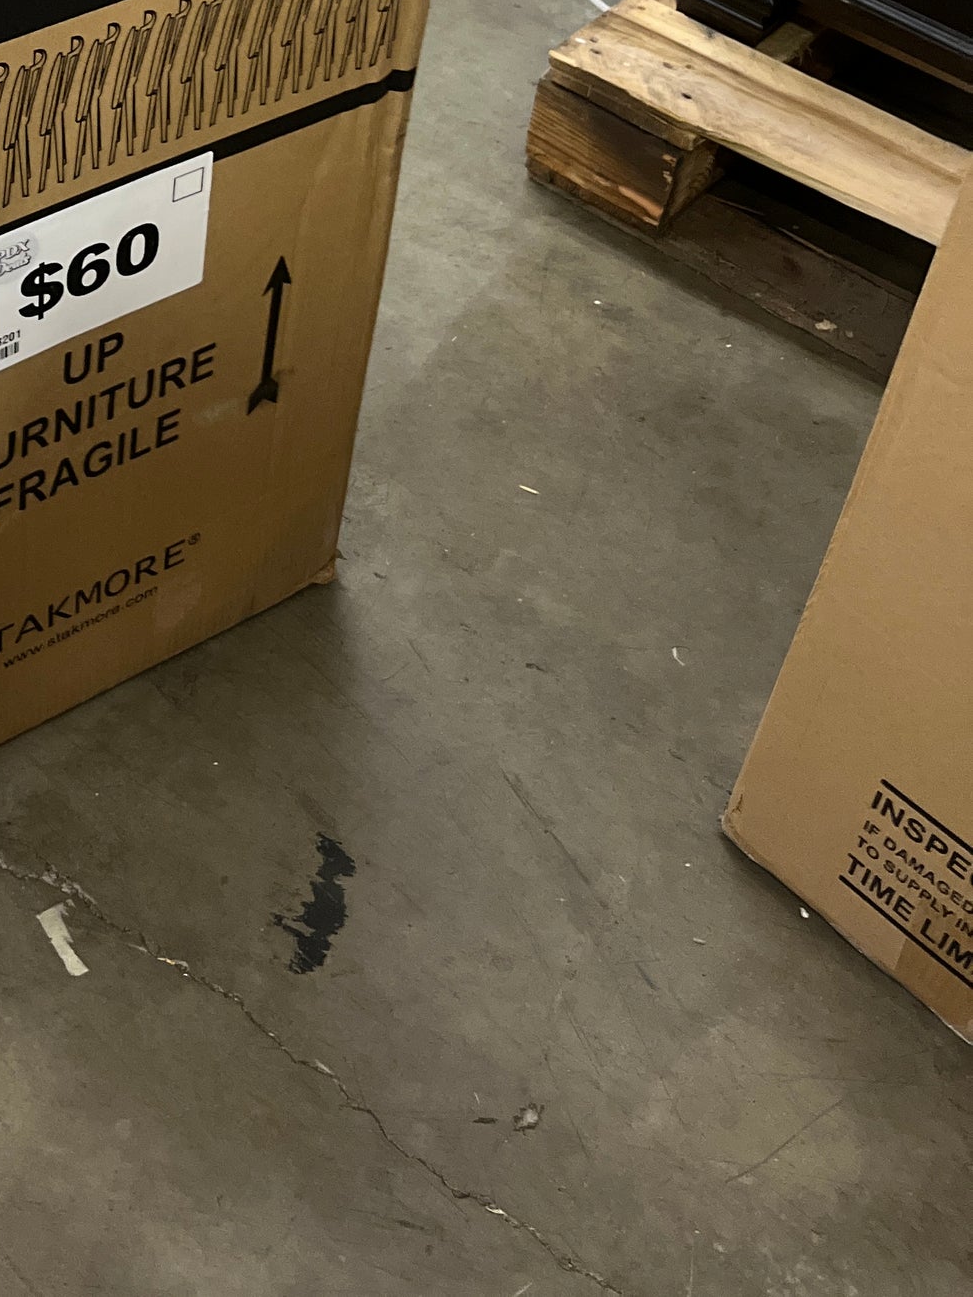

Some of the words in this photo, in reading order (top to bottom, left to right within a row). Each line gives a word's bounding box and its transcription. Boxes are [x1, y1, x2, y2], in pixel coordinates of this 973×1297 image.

[18, 222, 160, 321] $60
[63, 332, 124, 385] UP
[3, 586, 158, 668] www.stakmore.com
[863, 820, 881, 836] IF
[870, 790, 973, 886] INSPE
[847, 853, 915, 922] TIME
[857, 835, 879, 860] TO
[882, 860, 954, 918] SUPPLY
